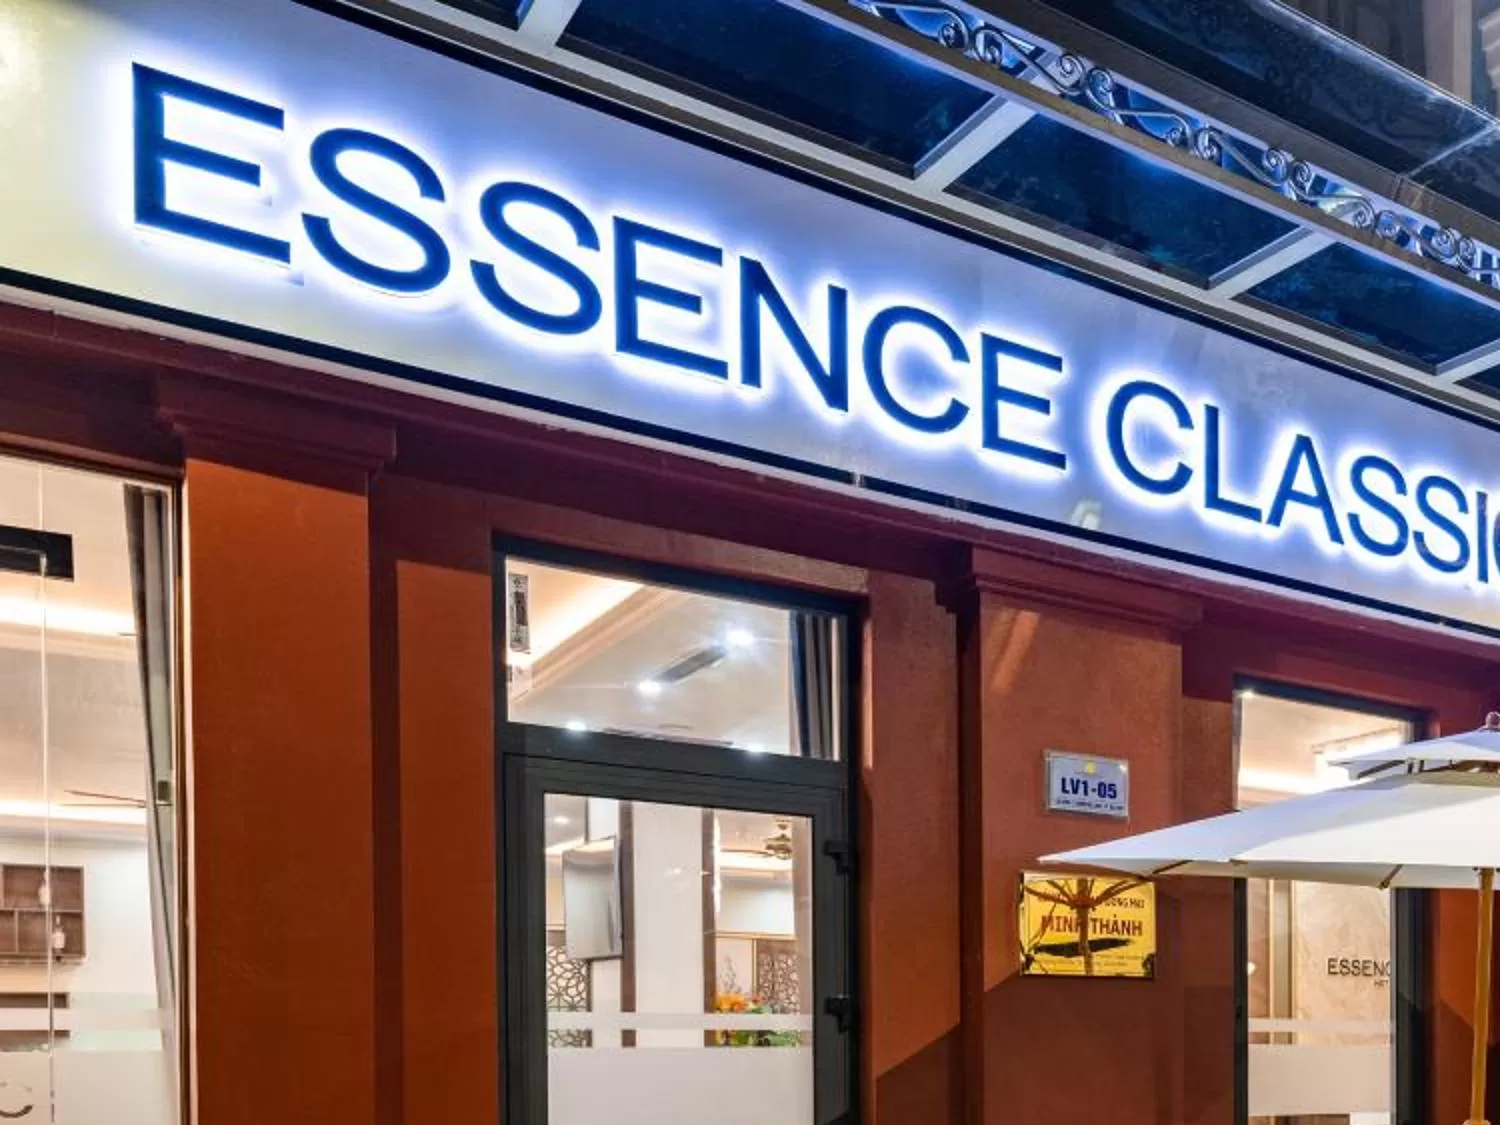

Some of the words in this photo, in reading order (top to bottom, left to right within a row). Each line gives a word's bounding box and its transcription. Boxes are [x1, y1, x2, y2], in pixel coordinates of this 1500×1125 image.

[132, 62, 1067, 470] ESSENCE
[1060, 777, 1117, 799] LV1-05
[1327, 957, 1392, 977] ESSENC
